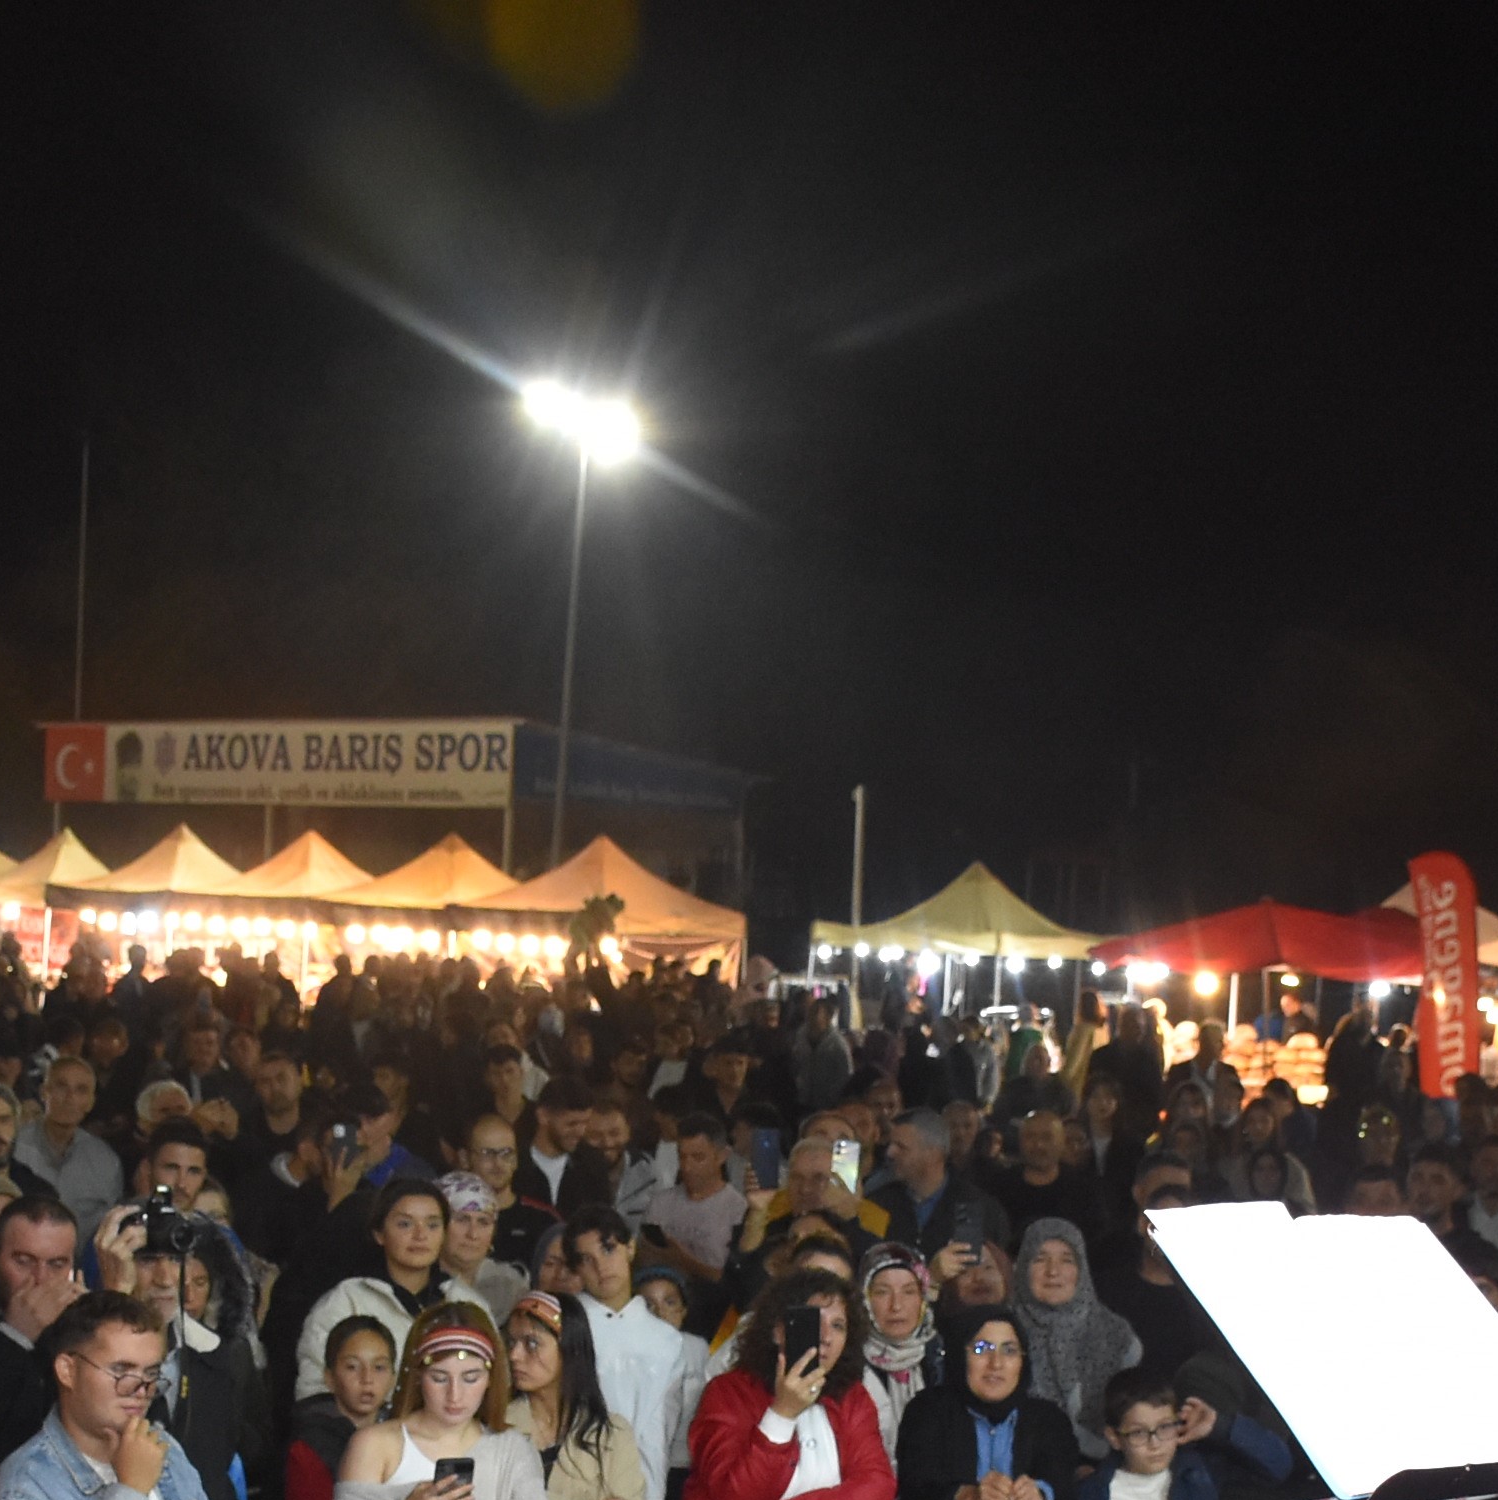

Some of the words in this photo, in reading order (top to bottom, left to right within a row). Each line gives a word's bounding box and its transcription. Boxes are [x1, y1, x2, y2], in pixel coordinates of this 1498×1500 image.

[182, 732, 293, 772] AKOVA
[302, 732, 403, 774] BARIŞ
[414, 732, 510, 773] SPOR
